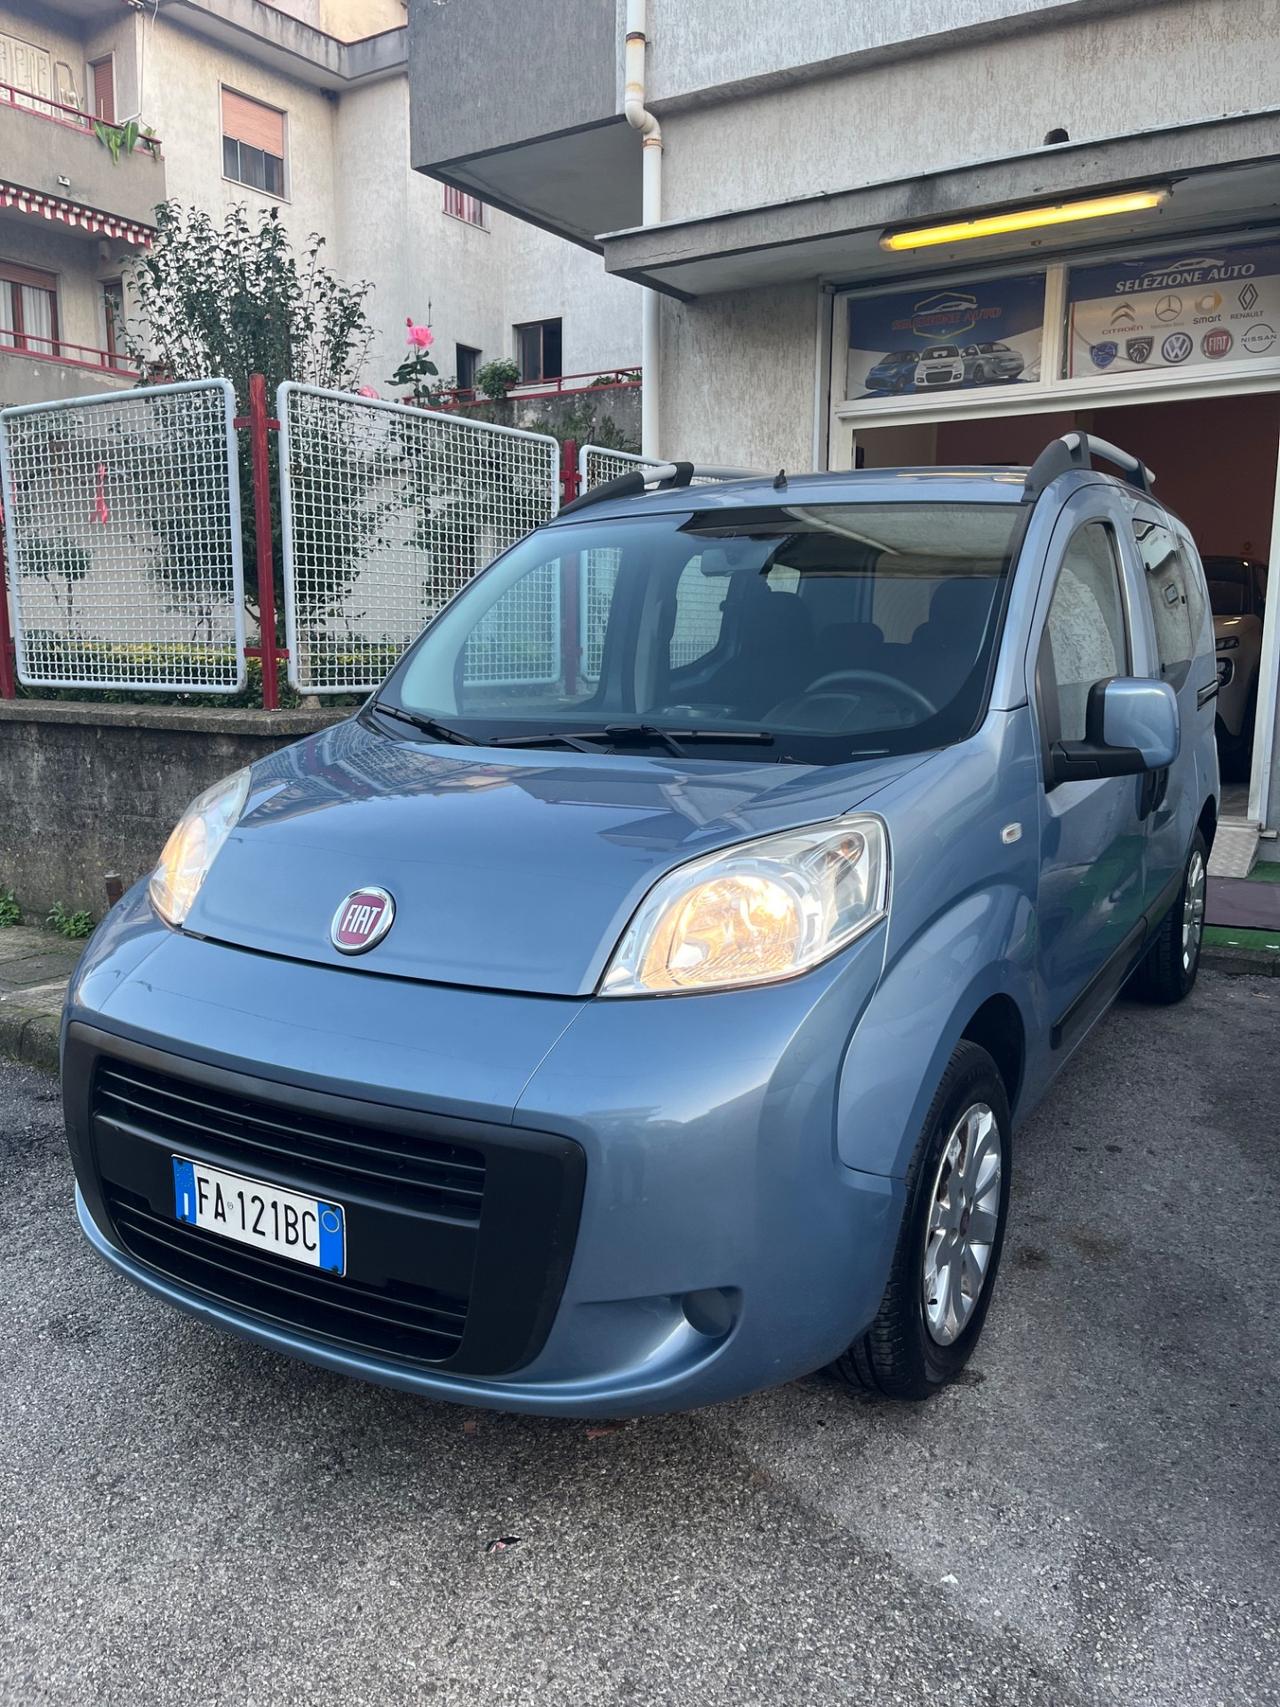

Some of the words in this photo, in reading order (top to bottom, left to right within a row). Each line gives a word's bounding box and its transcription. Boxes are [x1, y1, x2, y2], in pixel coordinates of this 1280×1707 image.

[1115, 270, 1202, 293] SELEZIONE
[1208, 263, 1256, 280] AUTO
[1193, 314, 1222, 325] smart
[1230, 311, 1264, 320] RENAULT
[1209, 335, 1228, 352] FIAT
[1241, 334, 1277, 343] NISSAN
[341, 904, 382, 934] FIAT
